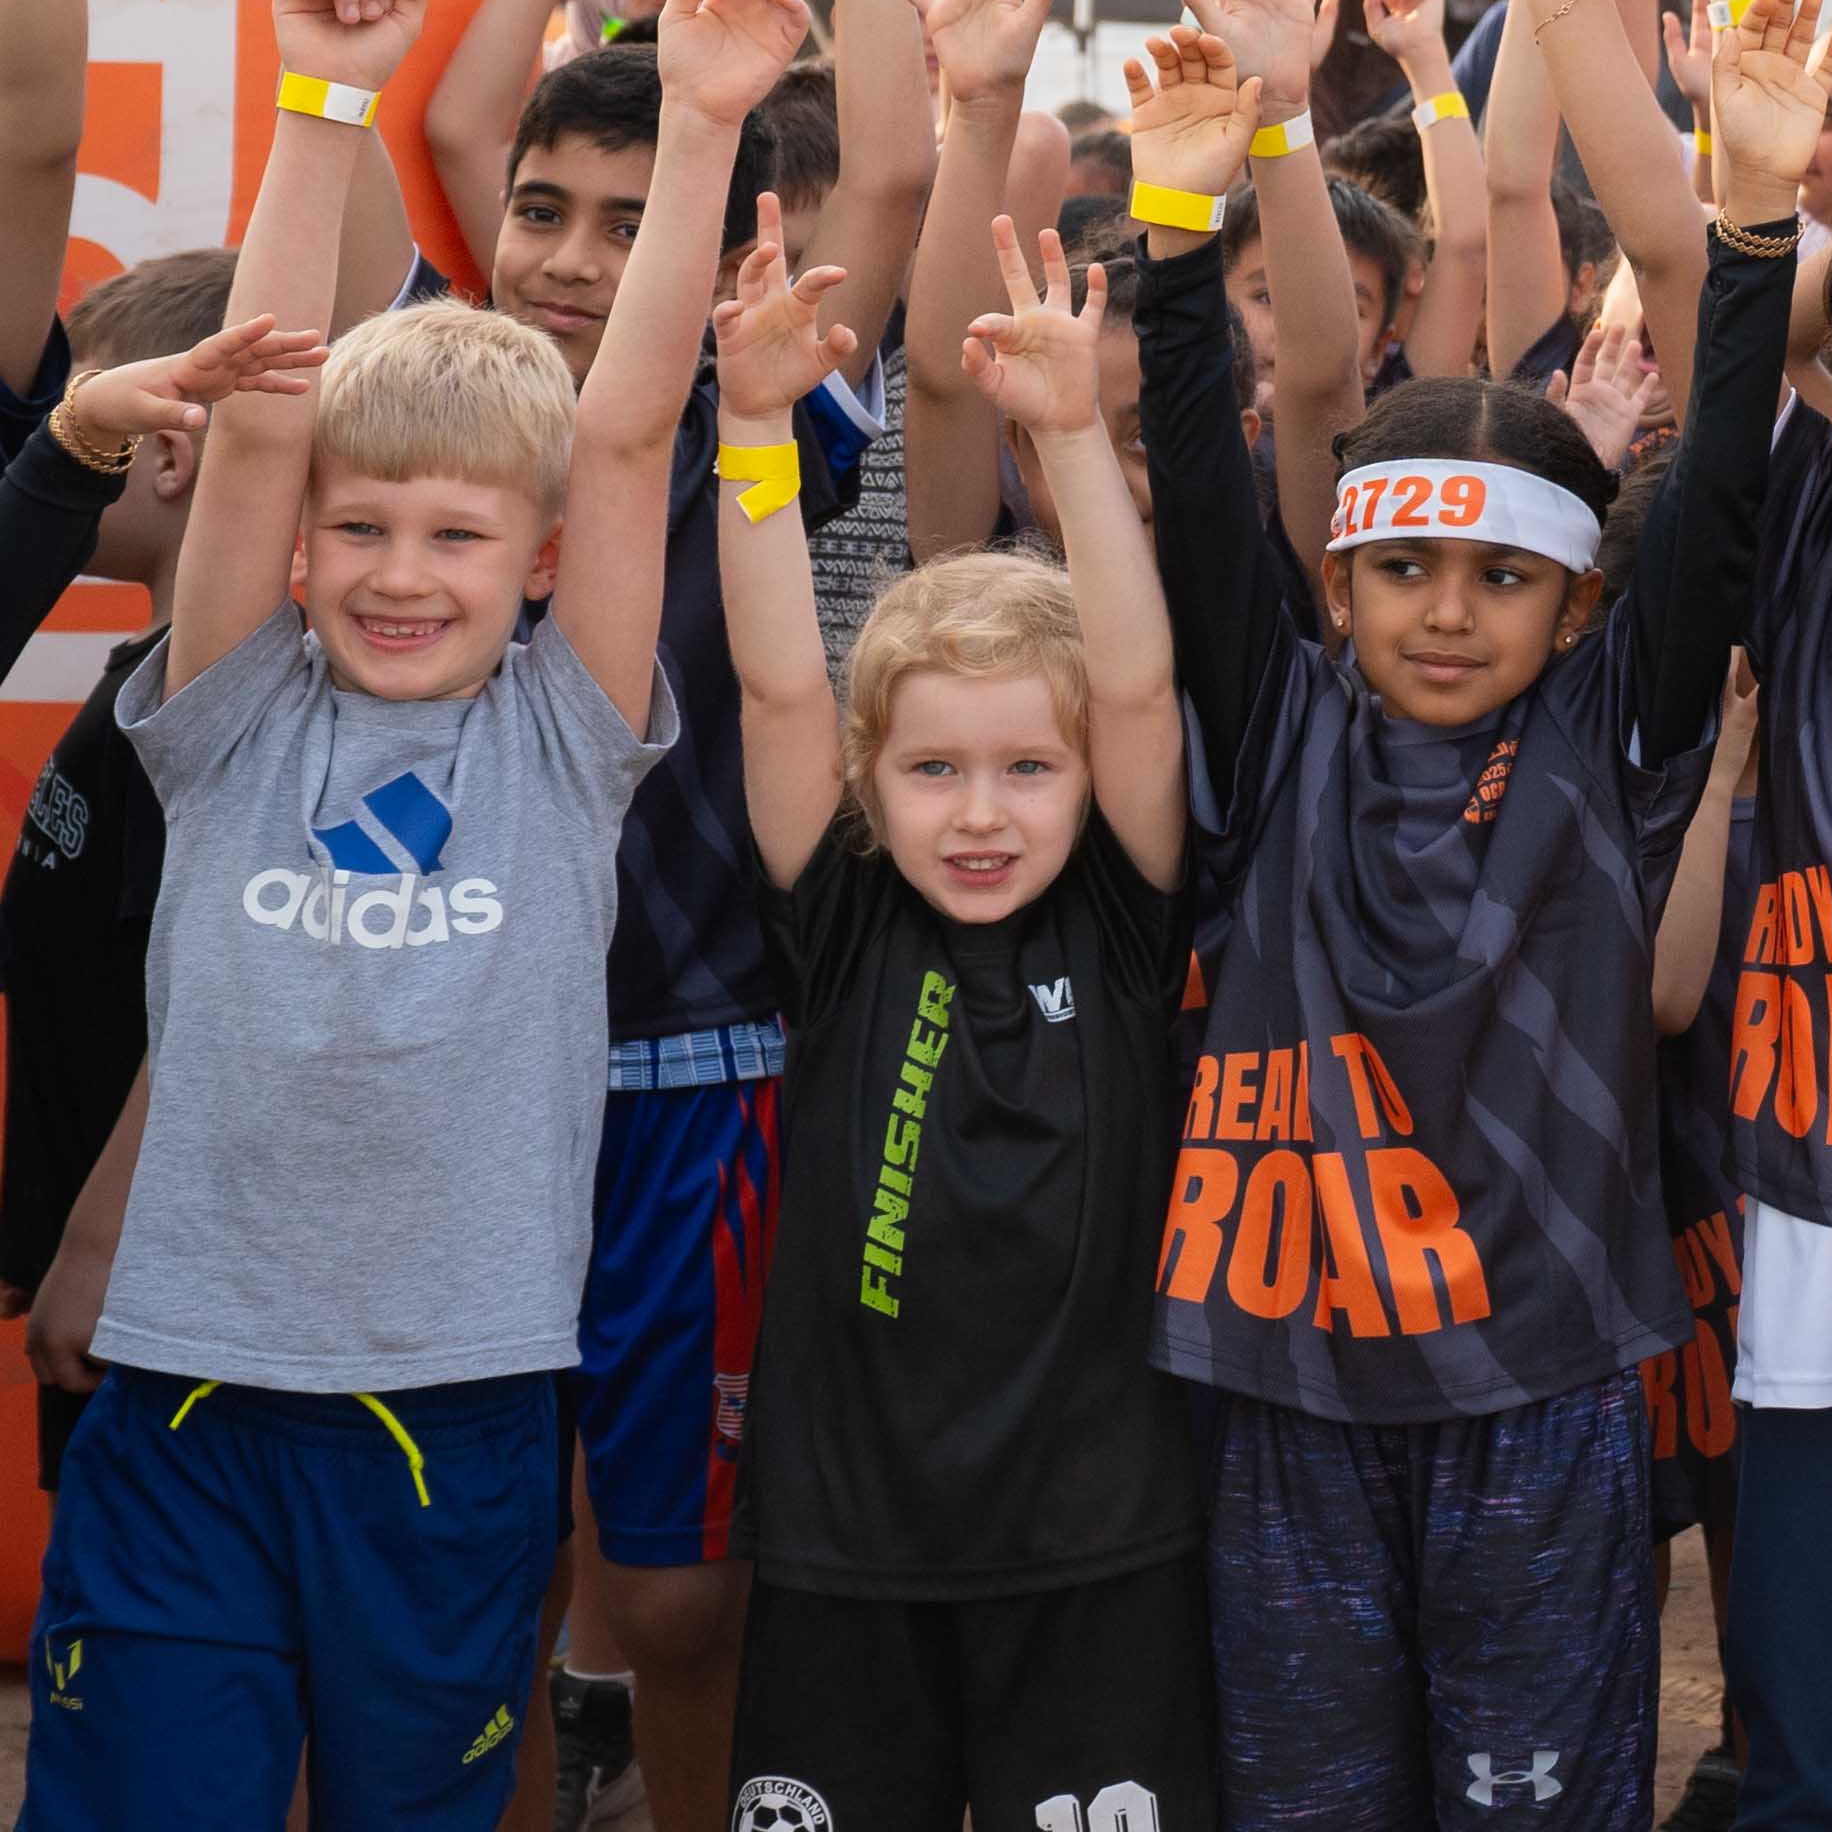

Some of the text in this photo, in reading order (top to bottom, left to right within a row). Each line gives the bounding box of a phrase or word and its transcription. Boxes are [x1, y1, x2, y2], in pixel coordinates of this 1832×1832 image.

[1343, 475, 1487, 536] 2729
[1330, 1031, 1414, 1138] TO
[859, 970, 957, 1319] FINISHER
[1155, 1147, 1492, 1339] ROAR
[739, 1781, 826, 1826] DEUTSCHLAND
